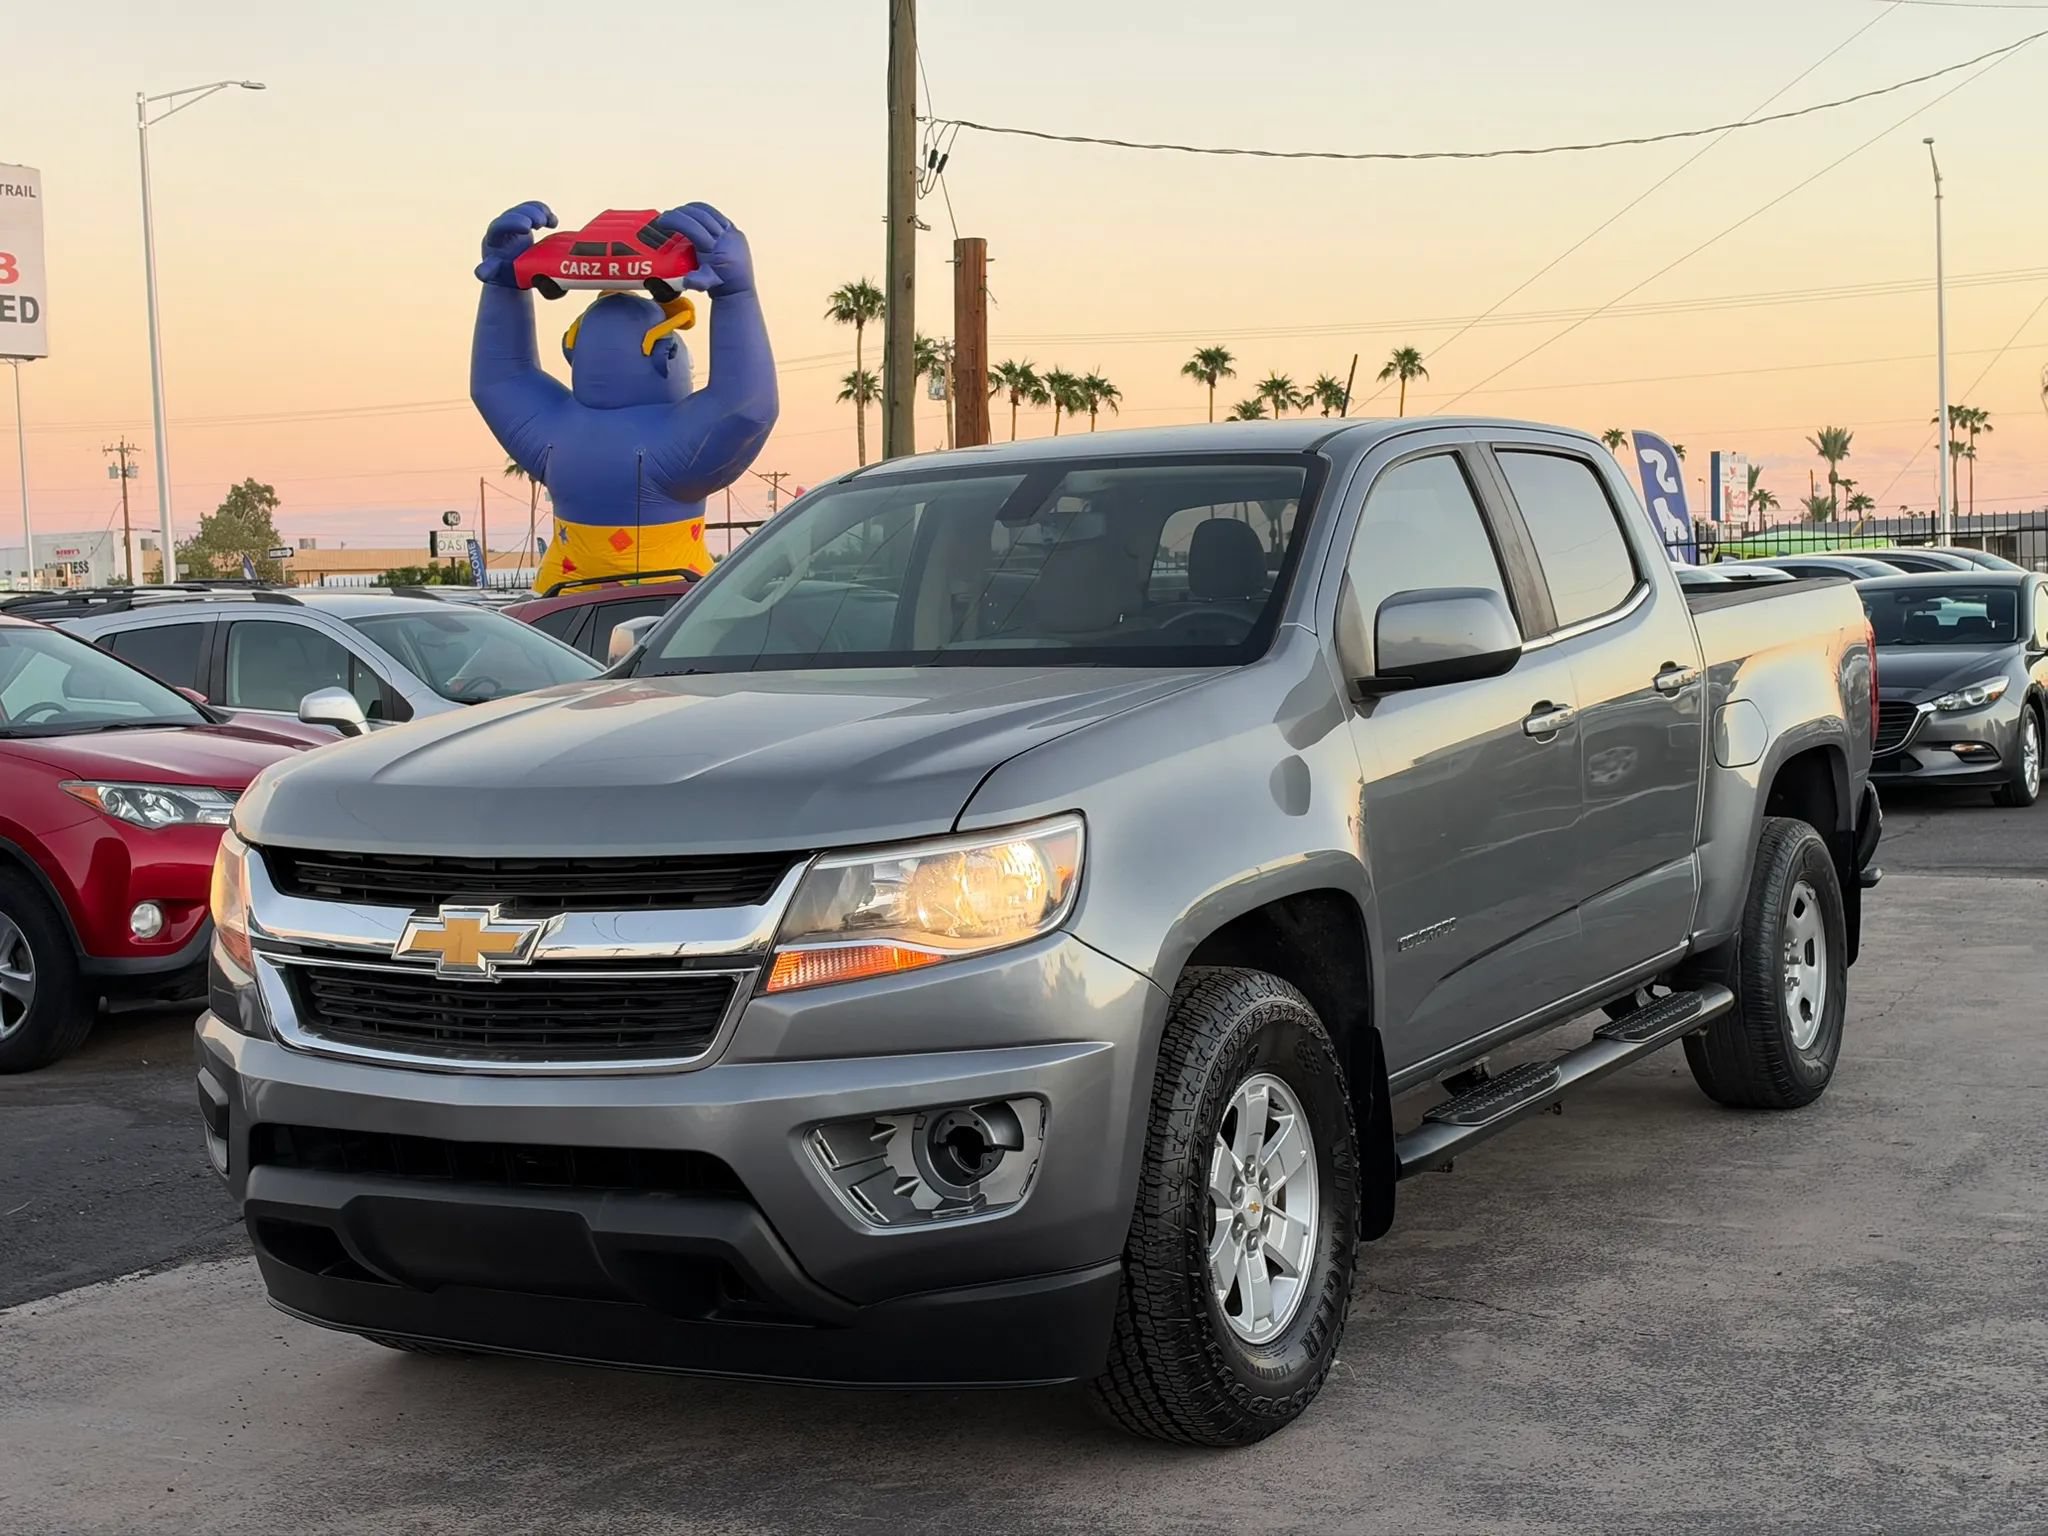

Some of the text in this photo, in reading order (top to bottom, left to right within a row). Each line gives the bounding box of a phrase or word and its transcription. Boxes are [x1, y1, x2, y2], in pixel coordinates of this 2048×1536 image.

[560, 260, 653, 276] CARZ R US
